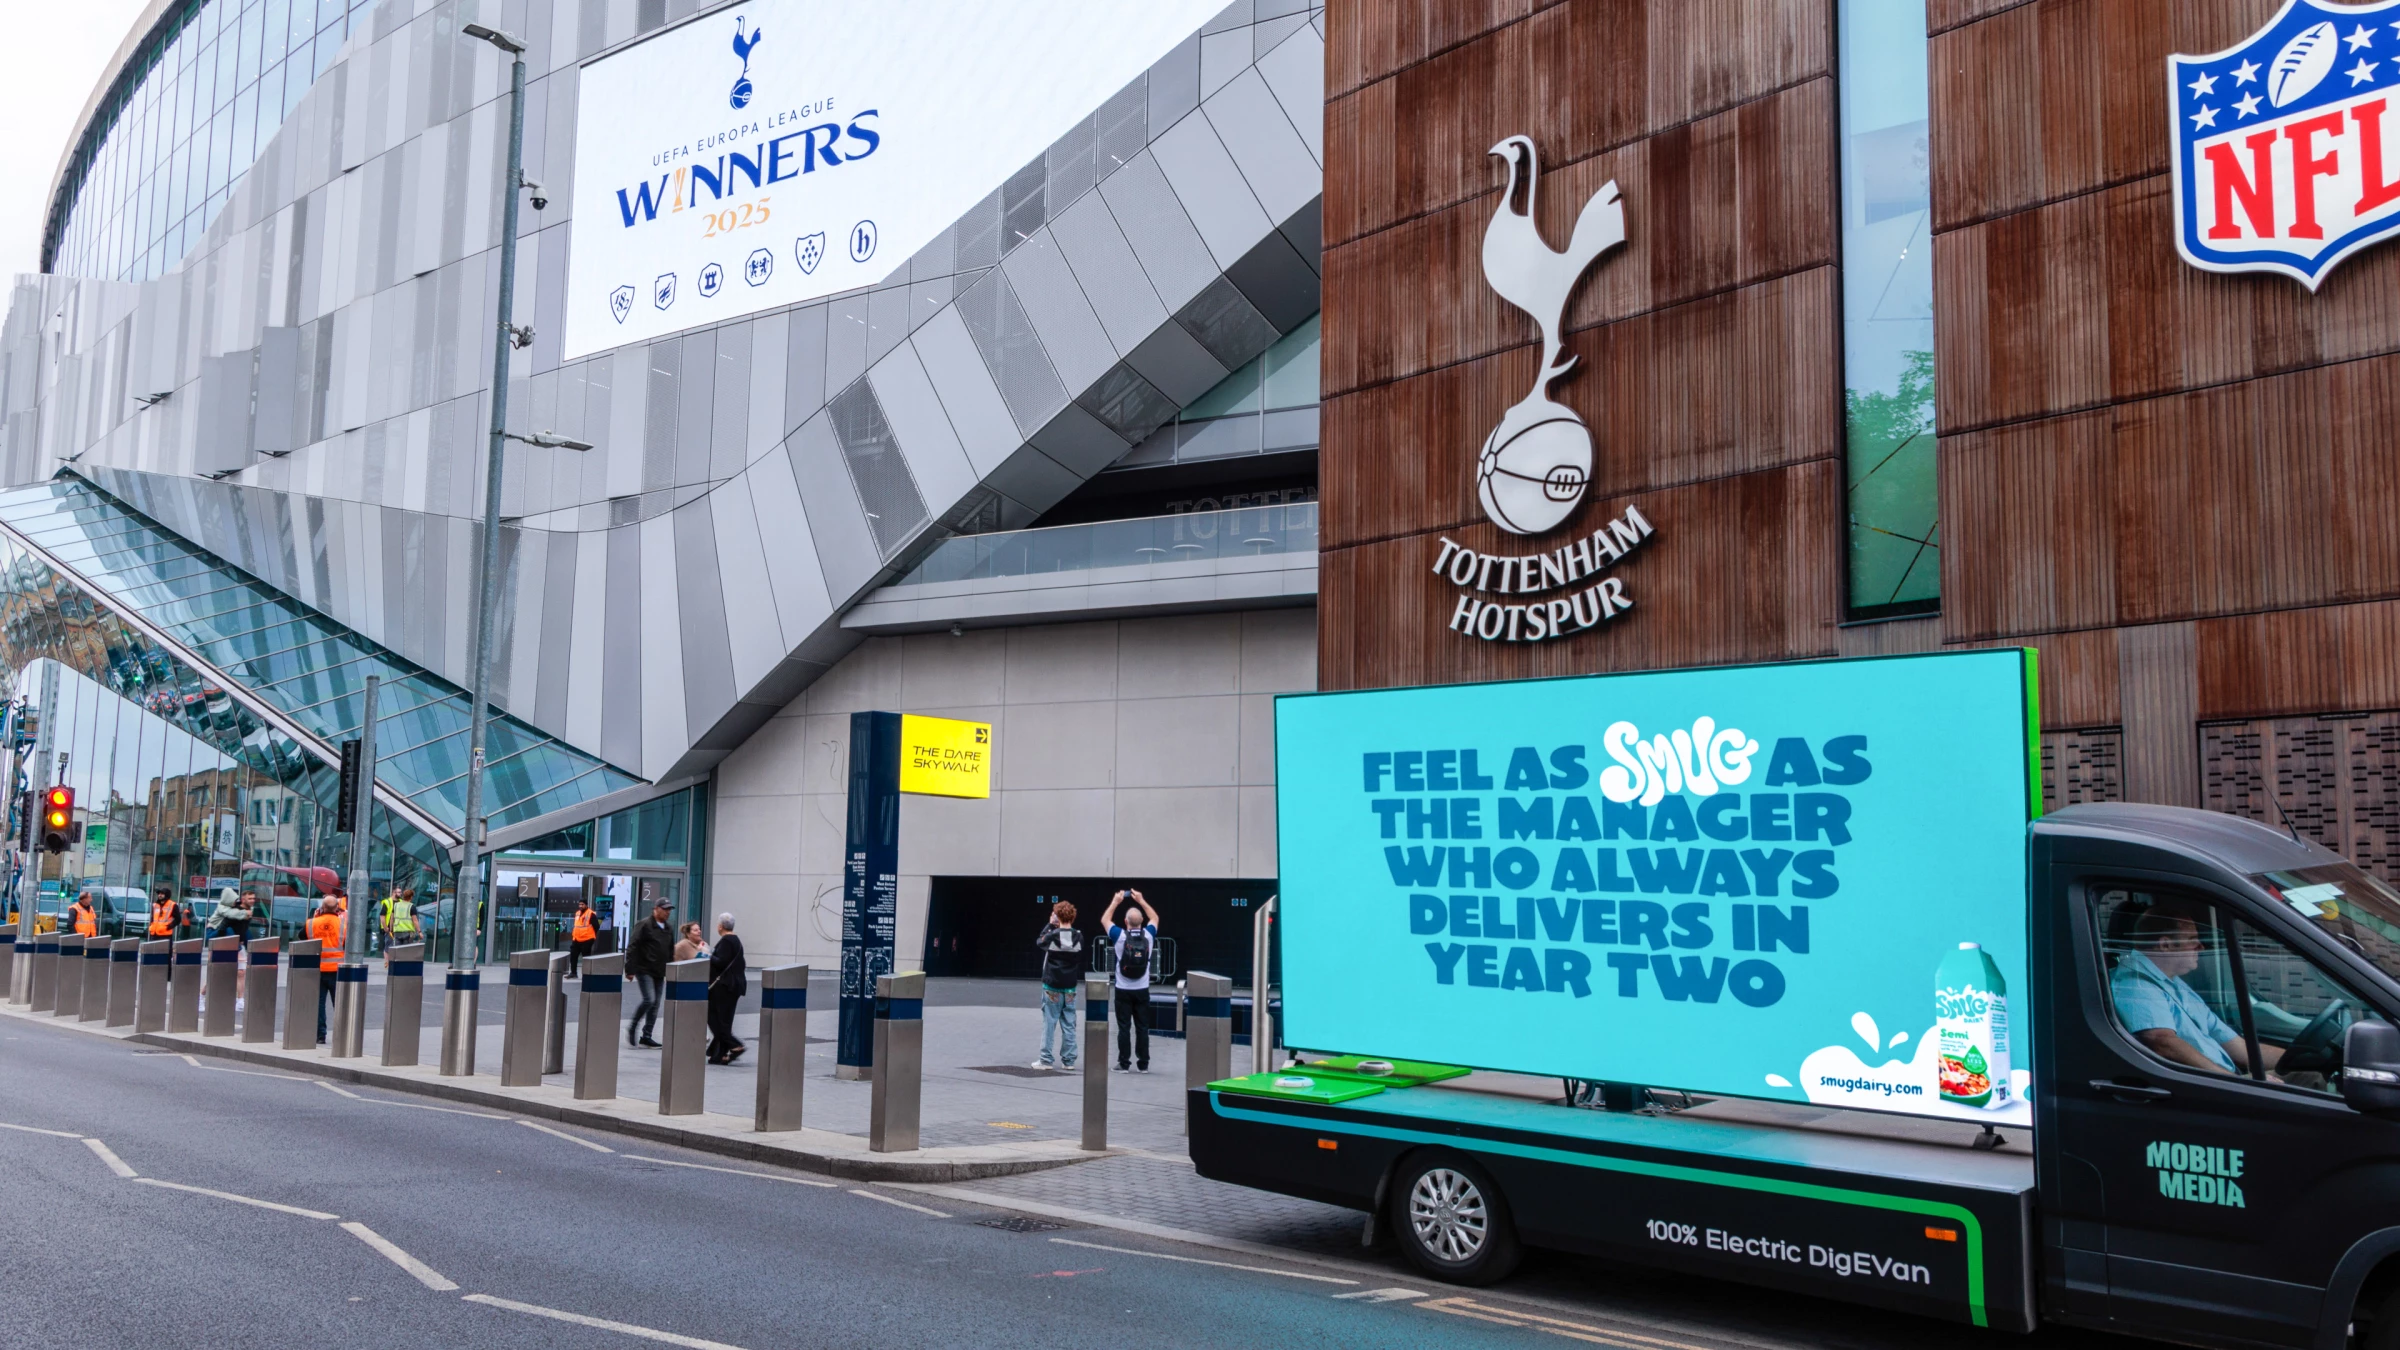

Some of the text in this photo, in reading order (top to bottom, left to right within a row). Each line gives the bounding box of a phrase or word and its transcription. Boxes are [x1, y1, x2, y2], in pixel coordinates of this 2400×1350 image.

[653, 97, 835, 167] UEFA EUROPA LEAGUE
[616, 109, 880, 228] WINNERS
[2204, 98, 2400, 240] NFL
[701, 197, 772, 239] 2025
[1432, 503, 1655, 593] TOTTENHAM
[1449, 577, 1634, 641] HOTSPUR
[913, 745, 982, 761] THE DARE
[913, 758, 980, 773] SKYWALK
[1363, 716, 1872, 806] FEEL AS SMUG AS
[1372, 793, 1852, 846] THE MANAGER
[1384, 845, 1839, 899] WHO ALWAYS
[1409, 894, 1809, 954] DELIVERS IN
[1424, 942, 1786, 1008] YEAR TWO
[1936, 995, 1988, 1019] SMUG
[1940, 1028, 1969, 1040] Semi
[1820, 1076, 1922, 1096] smugdairy.com
[2146, 1141, 2244, 1178] MOBILE
[2159, 1170, 2245, 1208] MEDIA
[1646, 1219, 1930, 1284] 100% Electric DigEVan
